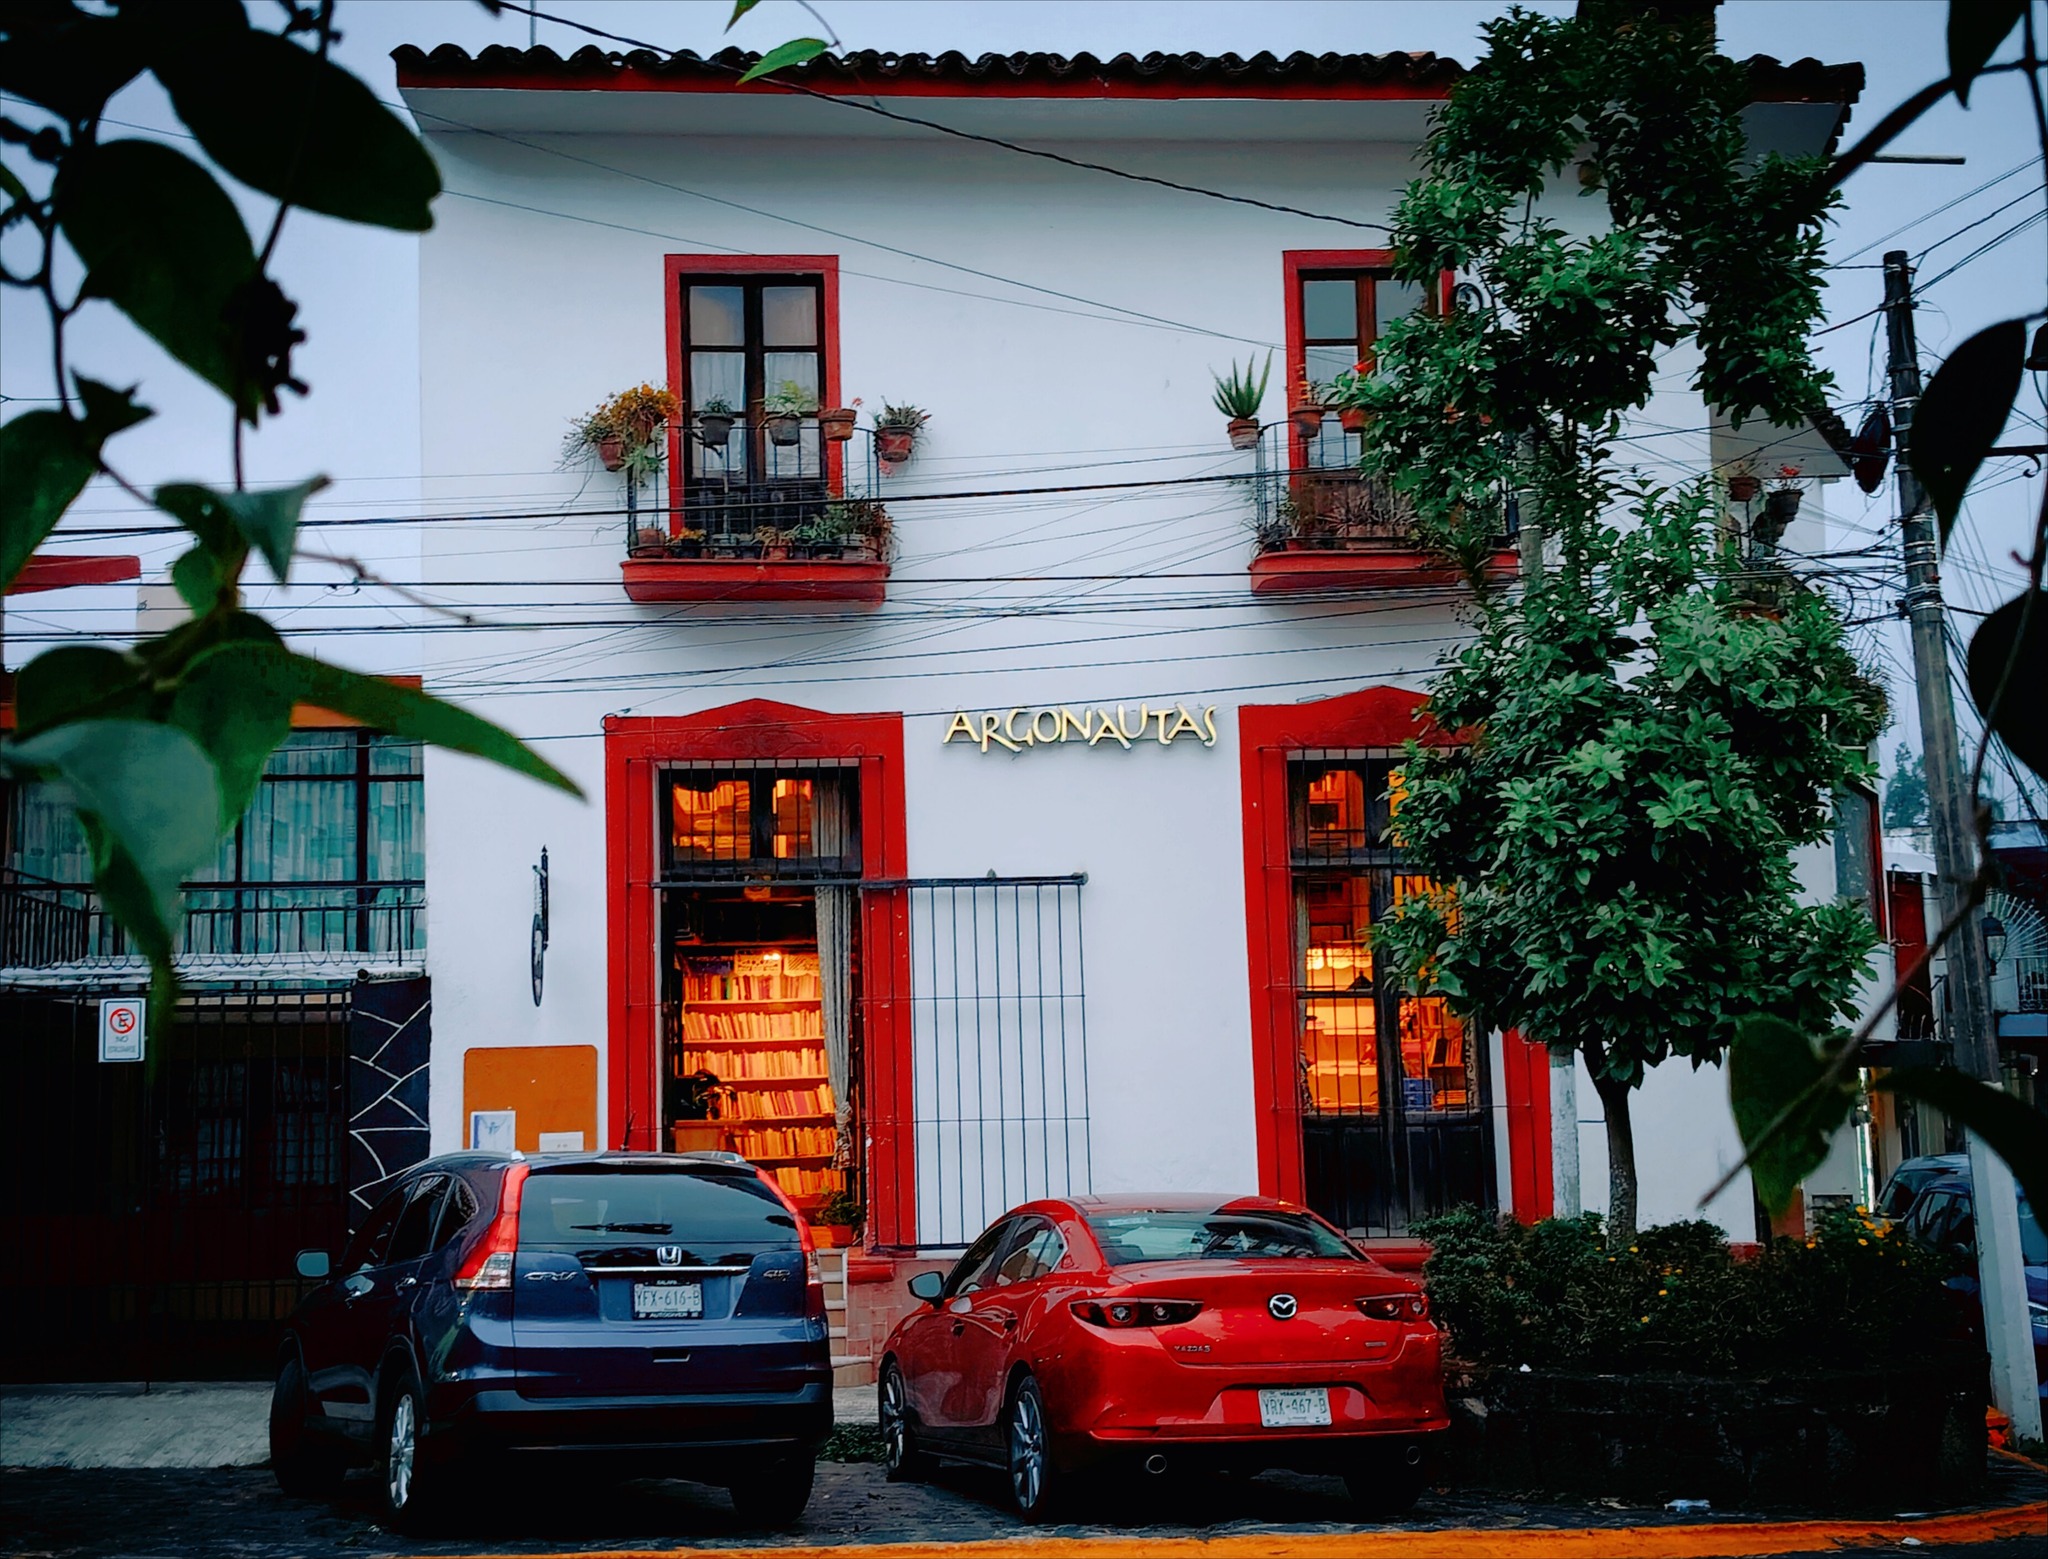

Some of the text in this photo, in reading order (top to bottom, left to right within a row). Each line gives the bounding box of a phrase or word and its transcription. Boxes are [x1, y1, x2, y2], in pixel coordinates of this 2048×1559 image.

[943, 703, 1217, 753] ARGONAUTAS
[635, 1289, 700, 1306] YFX-616-B
[1263, 1397, 1327, 1415] YRX-467-B
